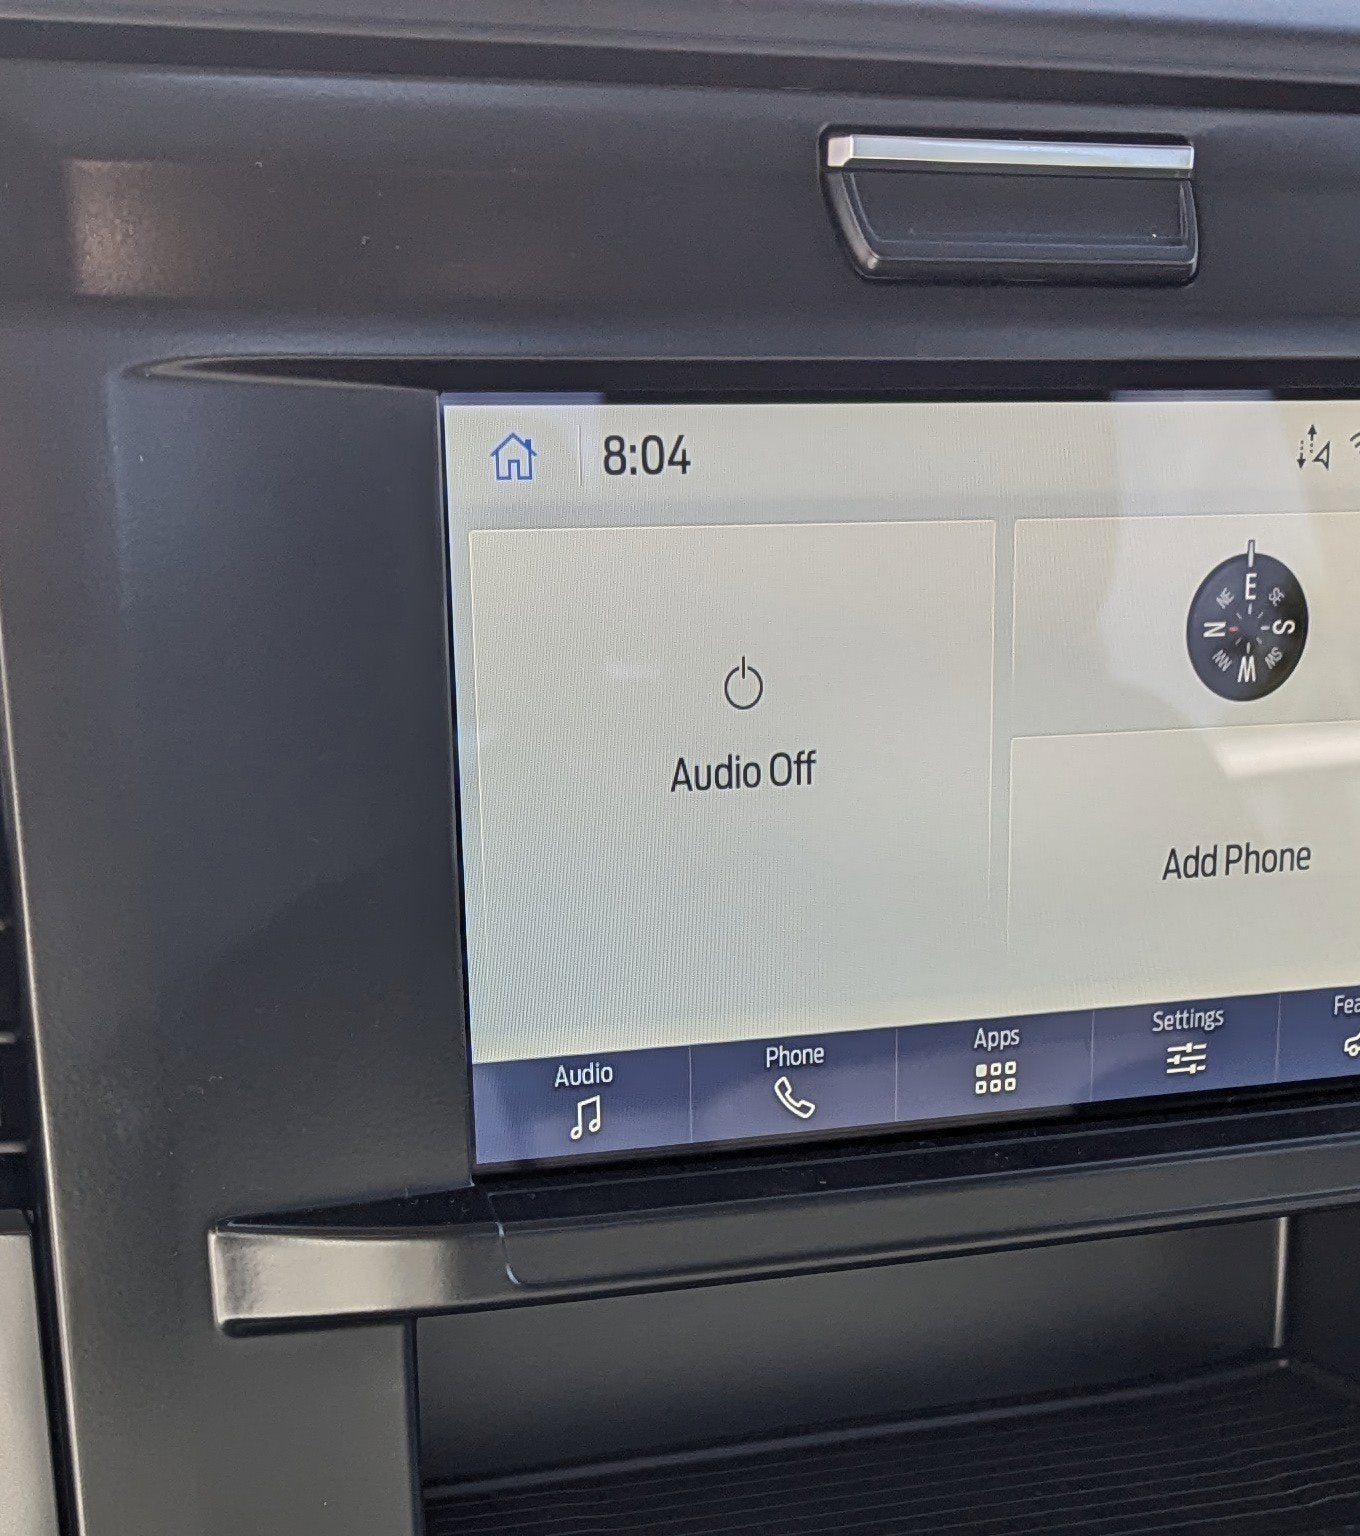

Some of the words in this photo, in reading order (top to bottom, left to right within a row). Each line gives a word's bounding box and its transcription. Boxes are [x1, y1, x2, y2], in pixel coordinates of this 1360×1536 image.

[602, 433, 692, 477] 8:04
[1244, 572, 1258, 601] E
[1202, 620, 1227, 638] N
[1271, 618, 1296, 636] S
[1236, 654, 1258, 684] W
[670, 753, 761, 793] Audio
[768, 749, 818, 788] Off
[1161, 844, 1218, 881] Add
[1224, 841, 1313, 877] Phone
[1151, 1004, 1225, 1033] Settings
[973, 1026, 1021, 1053] Apps
[764, 1040, 826, 1069] Phone
[553, 1060, 615, 1089] Audio
